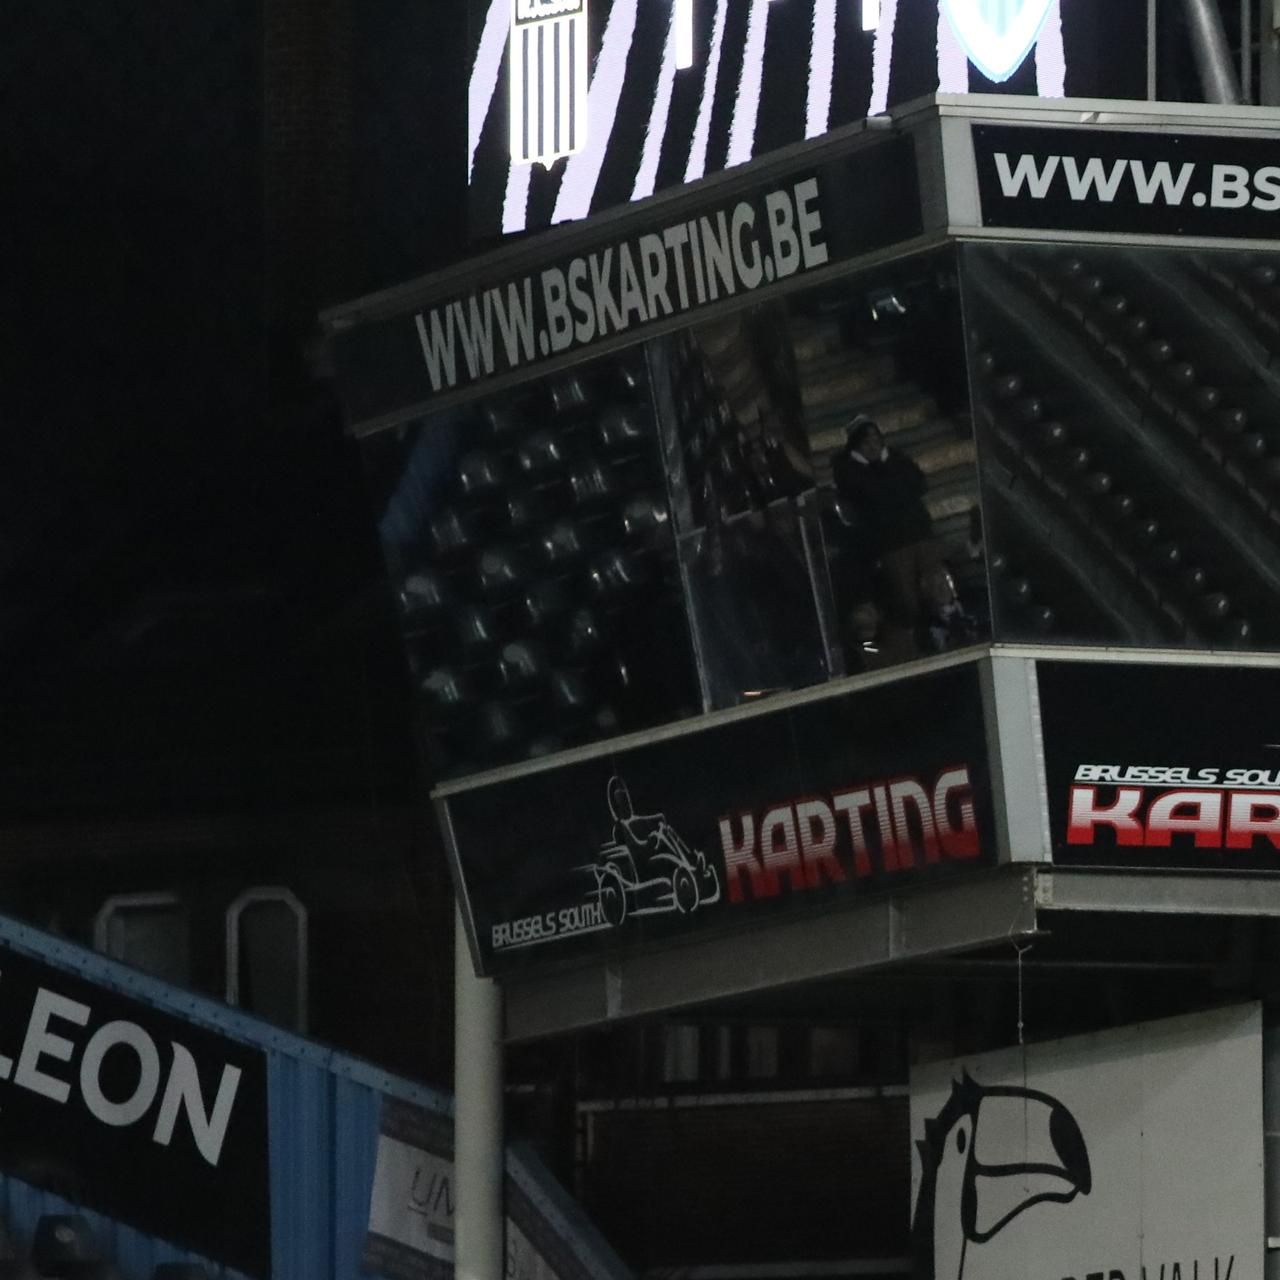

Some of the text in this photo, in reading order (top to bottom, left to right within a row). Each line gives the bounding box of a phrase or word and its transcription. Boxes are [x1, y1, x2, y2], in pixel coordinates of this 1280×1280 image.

[415, 176, 829, 393] WWW.BSKARTING.BE
[719, 764, 980, 902] KARTING
[1074, 763, 1220, 786] BRUSSELS
[492, 901, 602, 949] BRUSSELS SOUTH
[0, 987, 242, 1167] EON
